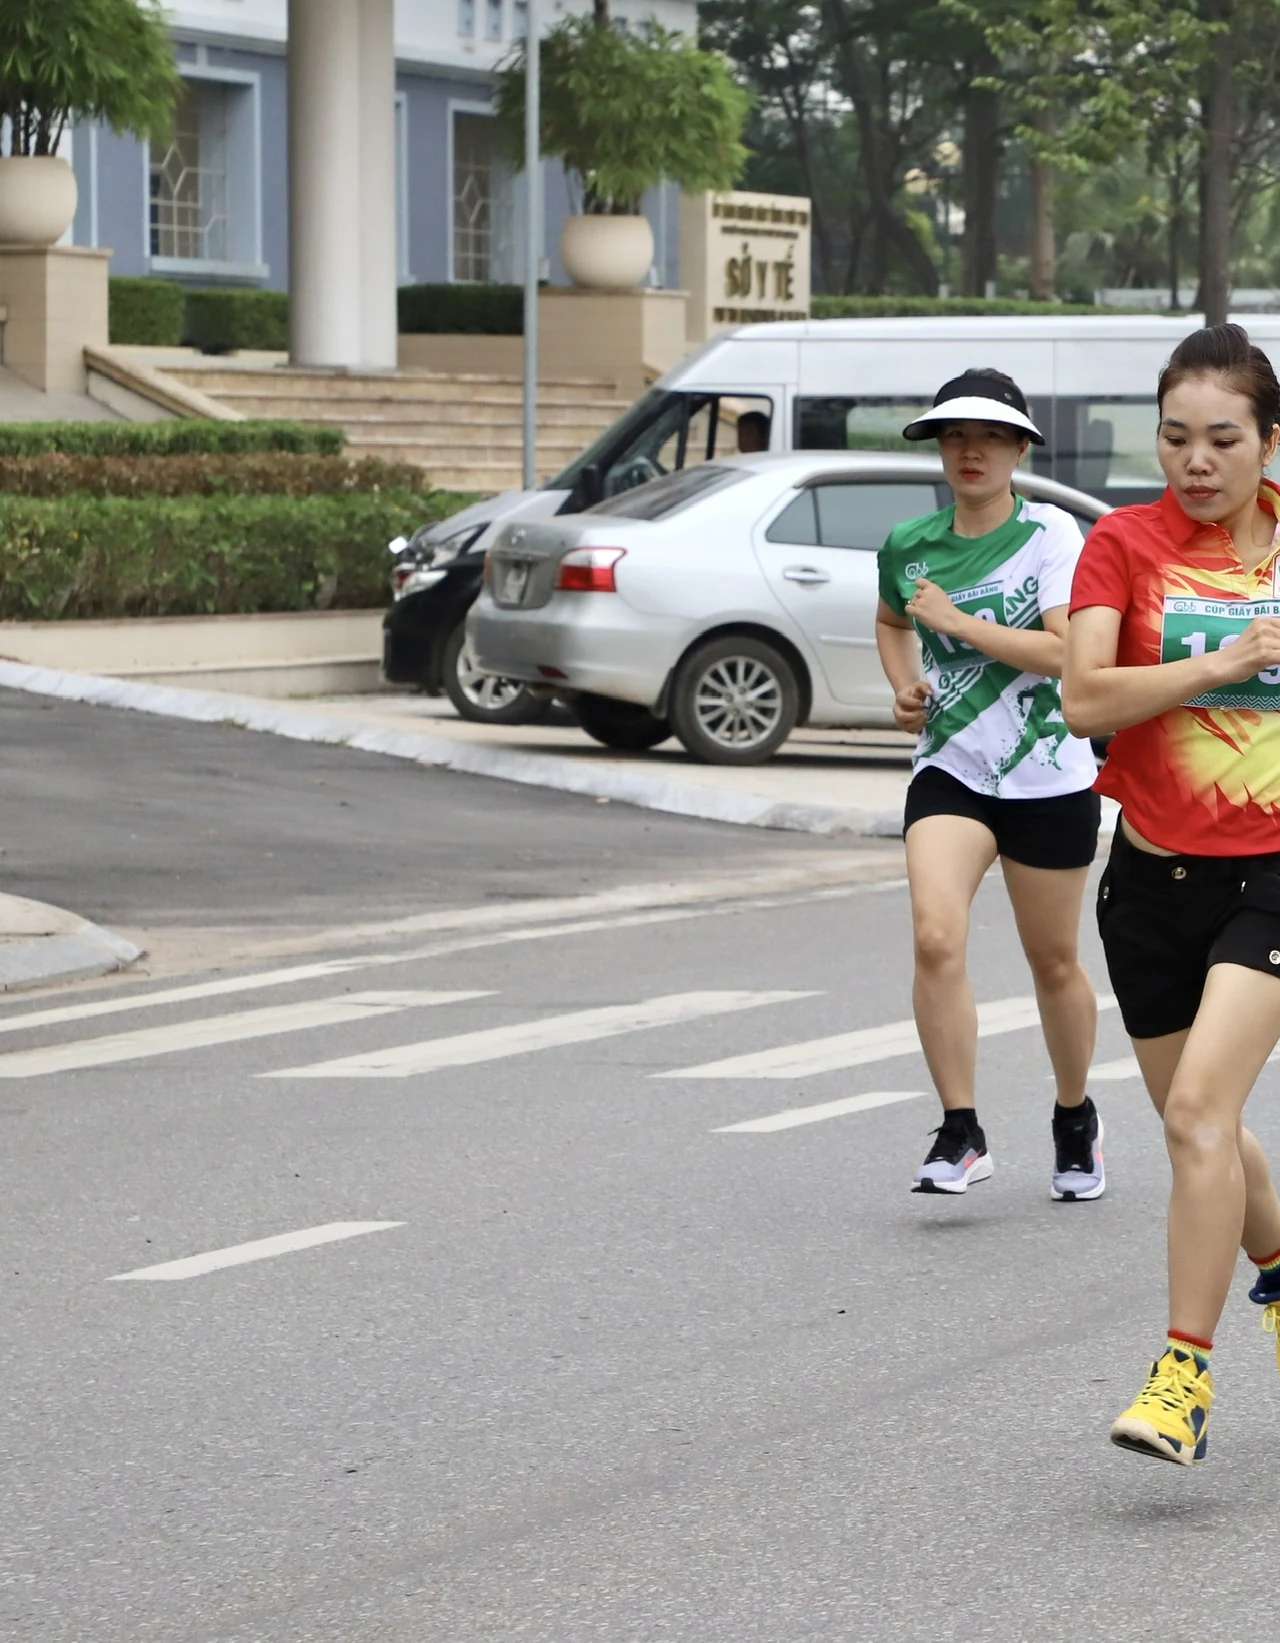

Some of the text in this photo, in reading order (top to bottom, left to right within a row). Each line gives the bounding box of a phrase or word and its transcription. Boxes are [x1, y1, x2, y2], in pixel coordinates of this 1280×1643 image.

[756, 261, 768, 300] Y
[773, 242, 795, 301] TẾ
[1204, 603, 1225, 615] CÚP
[1228, 604, 1251, 617] GIẤY
[1254, 604, 1270, 616] BÃI
